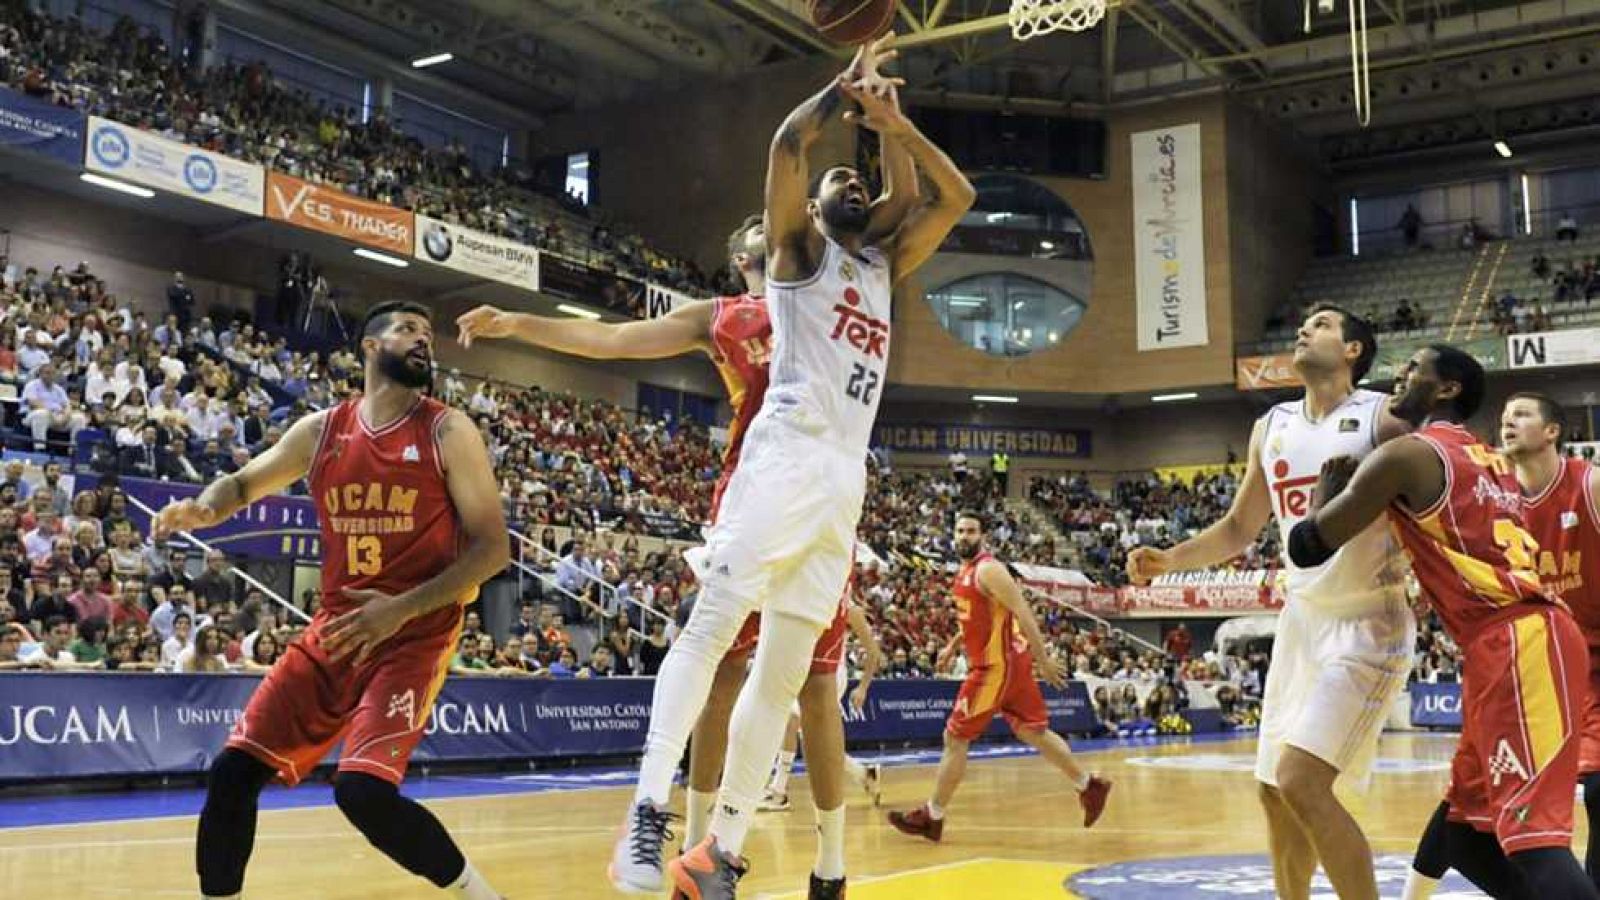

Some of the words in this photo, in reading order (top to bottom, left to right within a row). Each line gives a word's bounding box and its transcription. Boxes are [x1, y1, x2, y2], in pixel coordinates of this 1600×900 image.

[880, 427, 937, 450] UCAM
[945, 428, 1077, 455] UNIVERSIDAD
[324, 482, 419, 516] UCAM
[347, 535, 383, 576] 13
